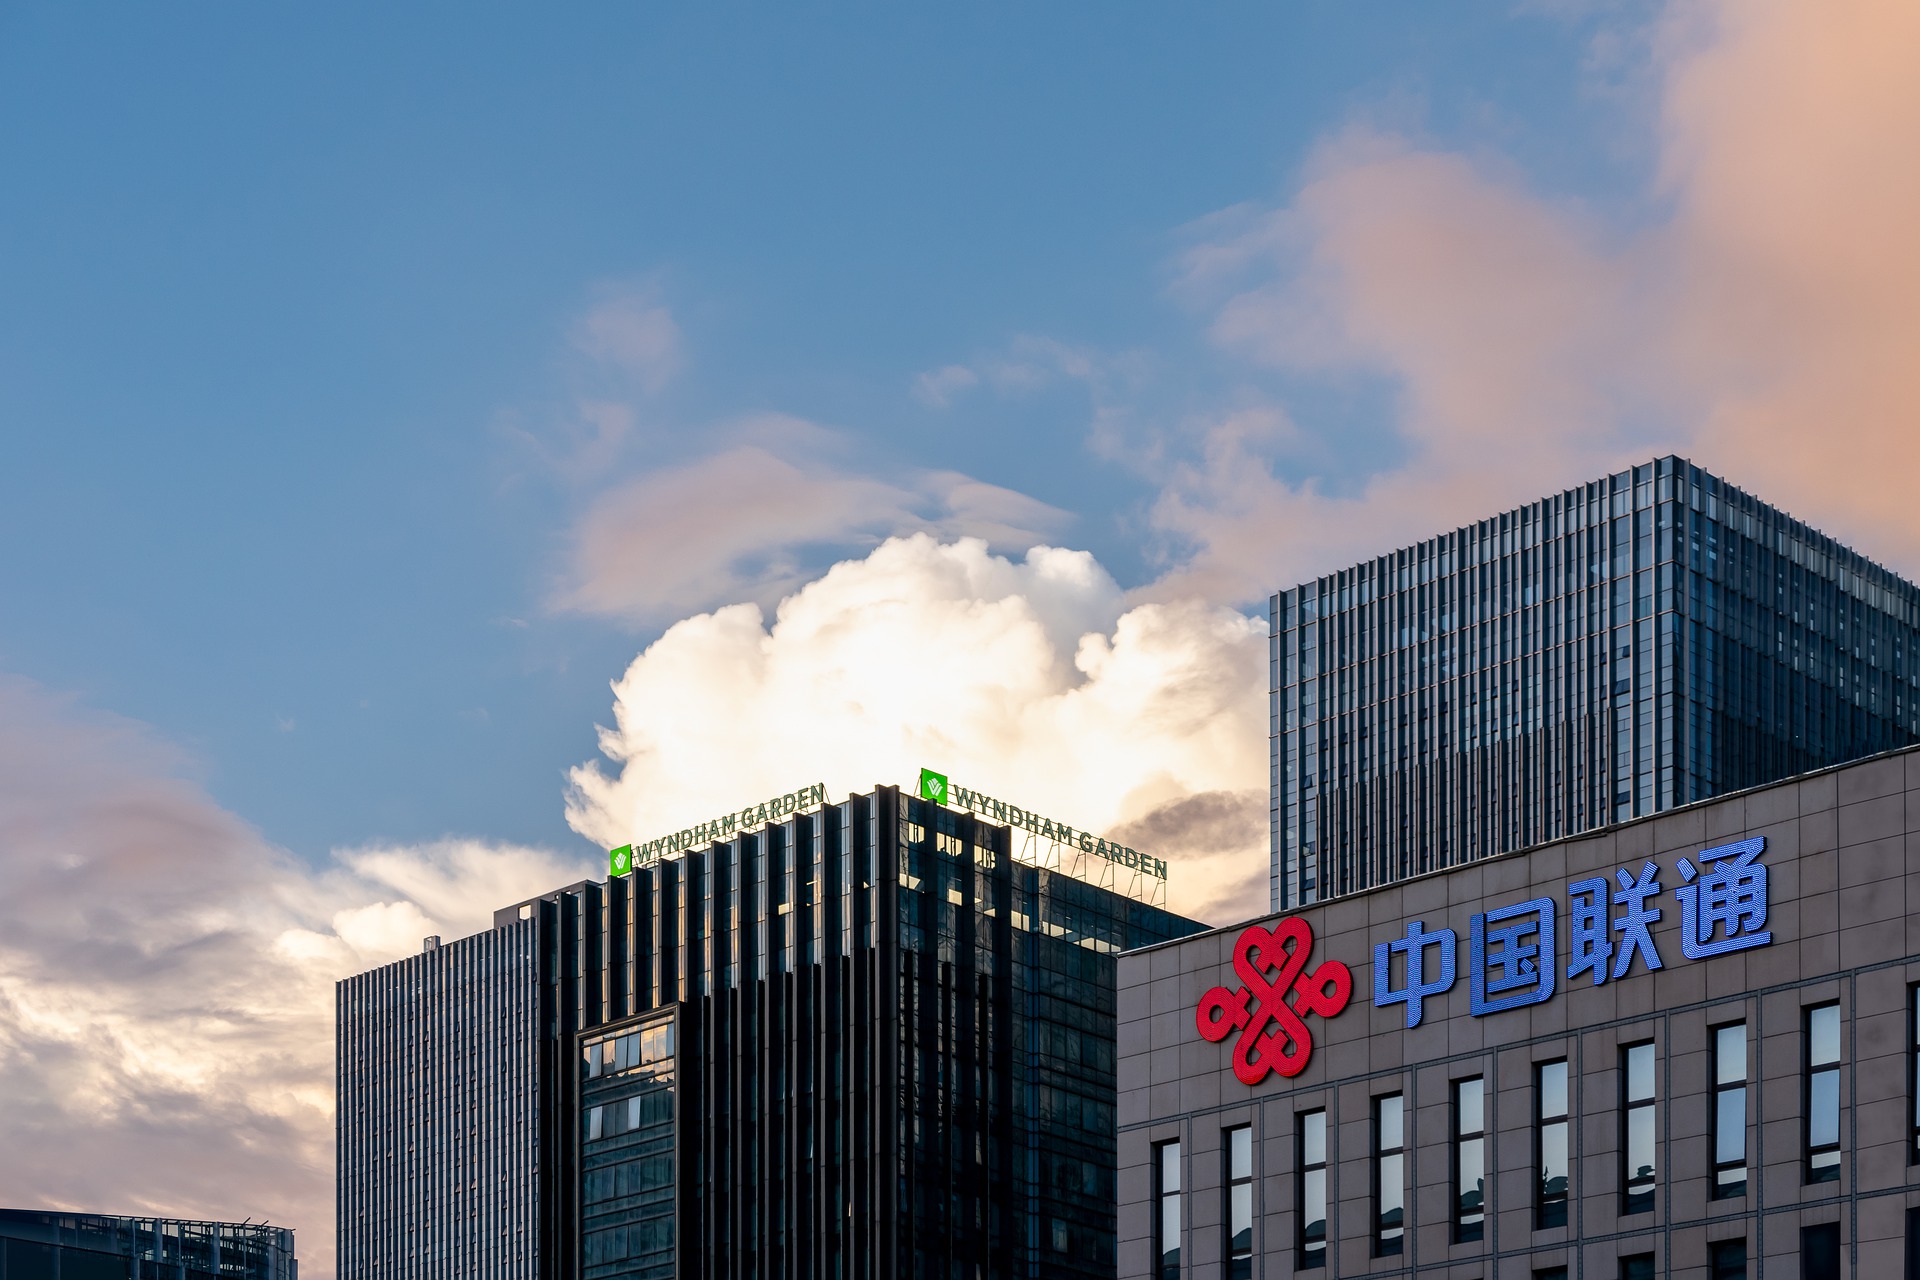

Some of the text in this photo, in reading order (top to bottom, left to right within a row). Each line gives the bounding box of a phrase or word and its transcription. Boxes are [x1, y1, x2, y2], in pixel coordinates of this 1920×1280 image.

[635, 782, 824, 864] WYNDHAM GARDEN
[954, 784, 1167, 880] WYNDHAM GARDEN
[1374, 835, 1773, 1028] 中国联通
